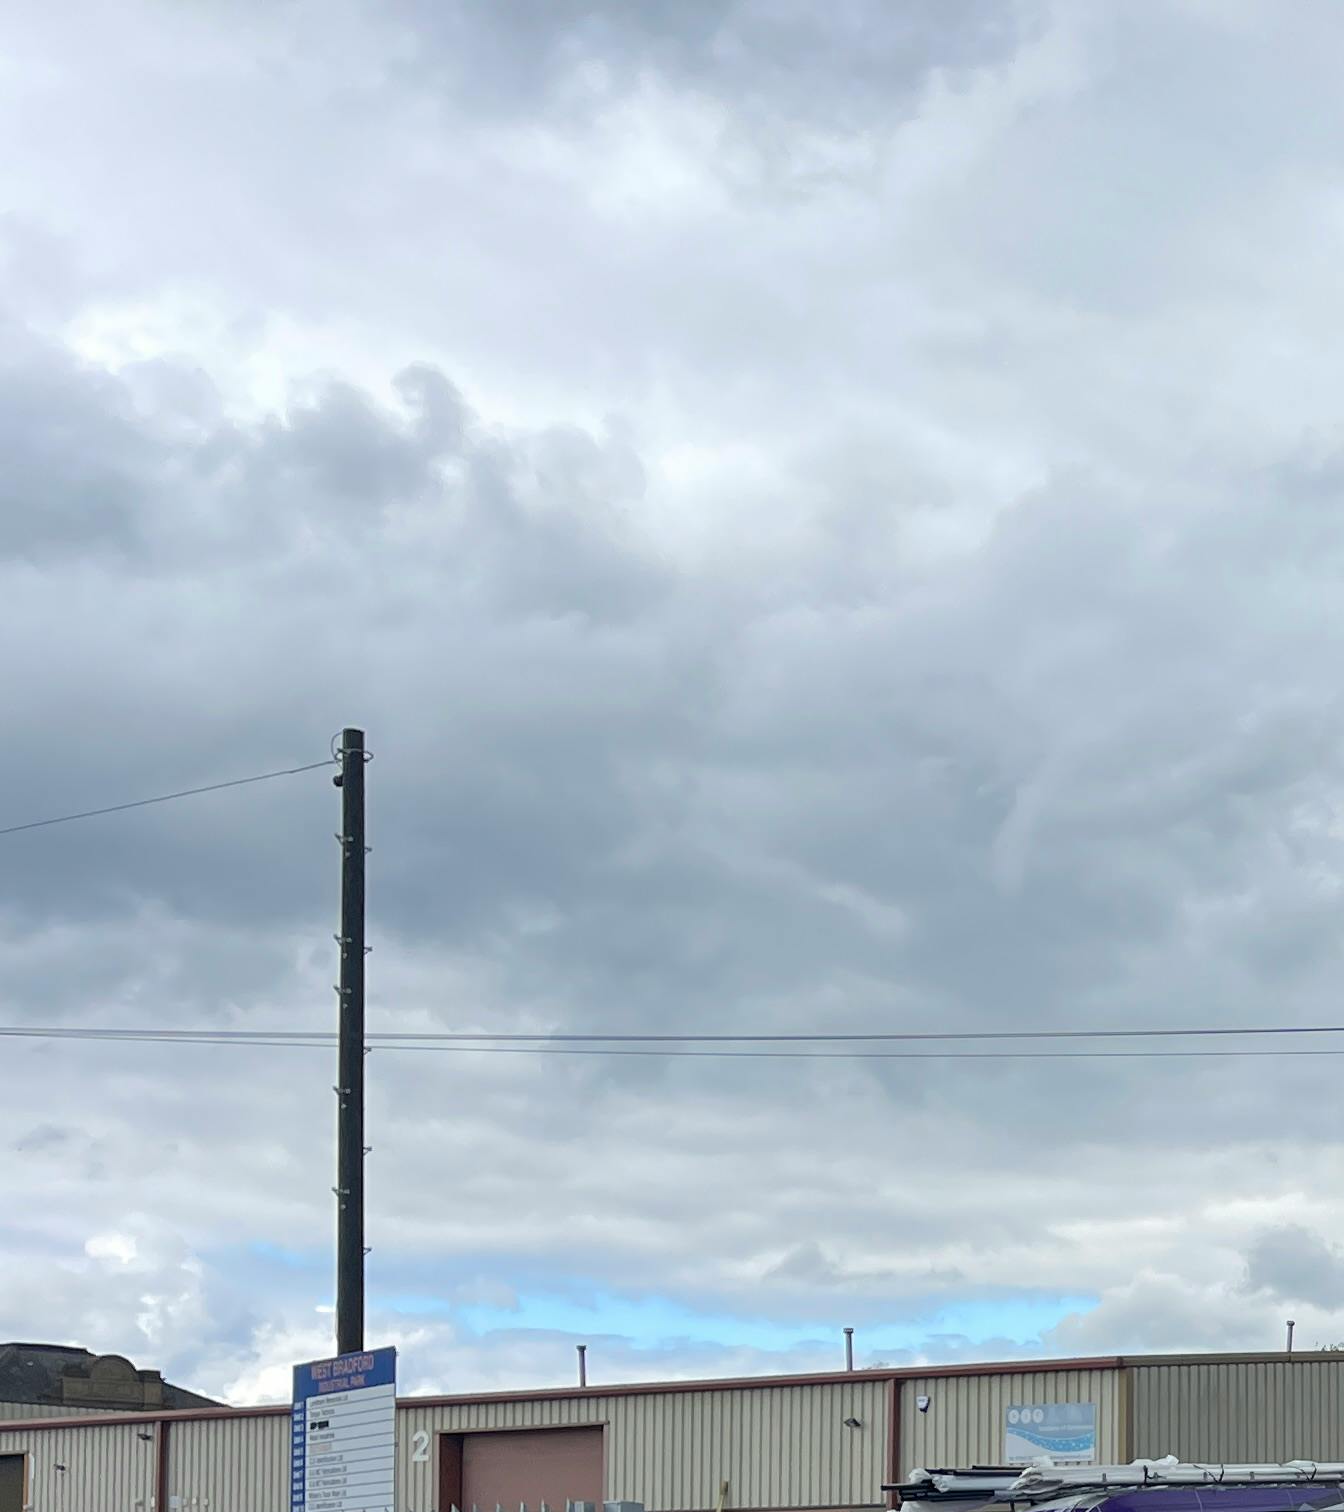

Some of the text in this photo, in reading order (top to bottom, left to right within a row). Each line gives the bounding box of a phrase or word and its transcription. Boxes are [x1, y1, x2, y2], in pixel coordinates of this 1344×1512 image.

[311, 1353, 374, 1380] WEST BRADFORD
[318, 1374, 366, 1393] INDUSTRIAL PARK
[411, 1430, 431, 1463] 2
